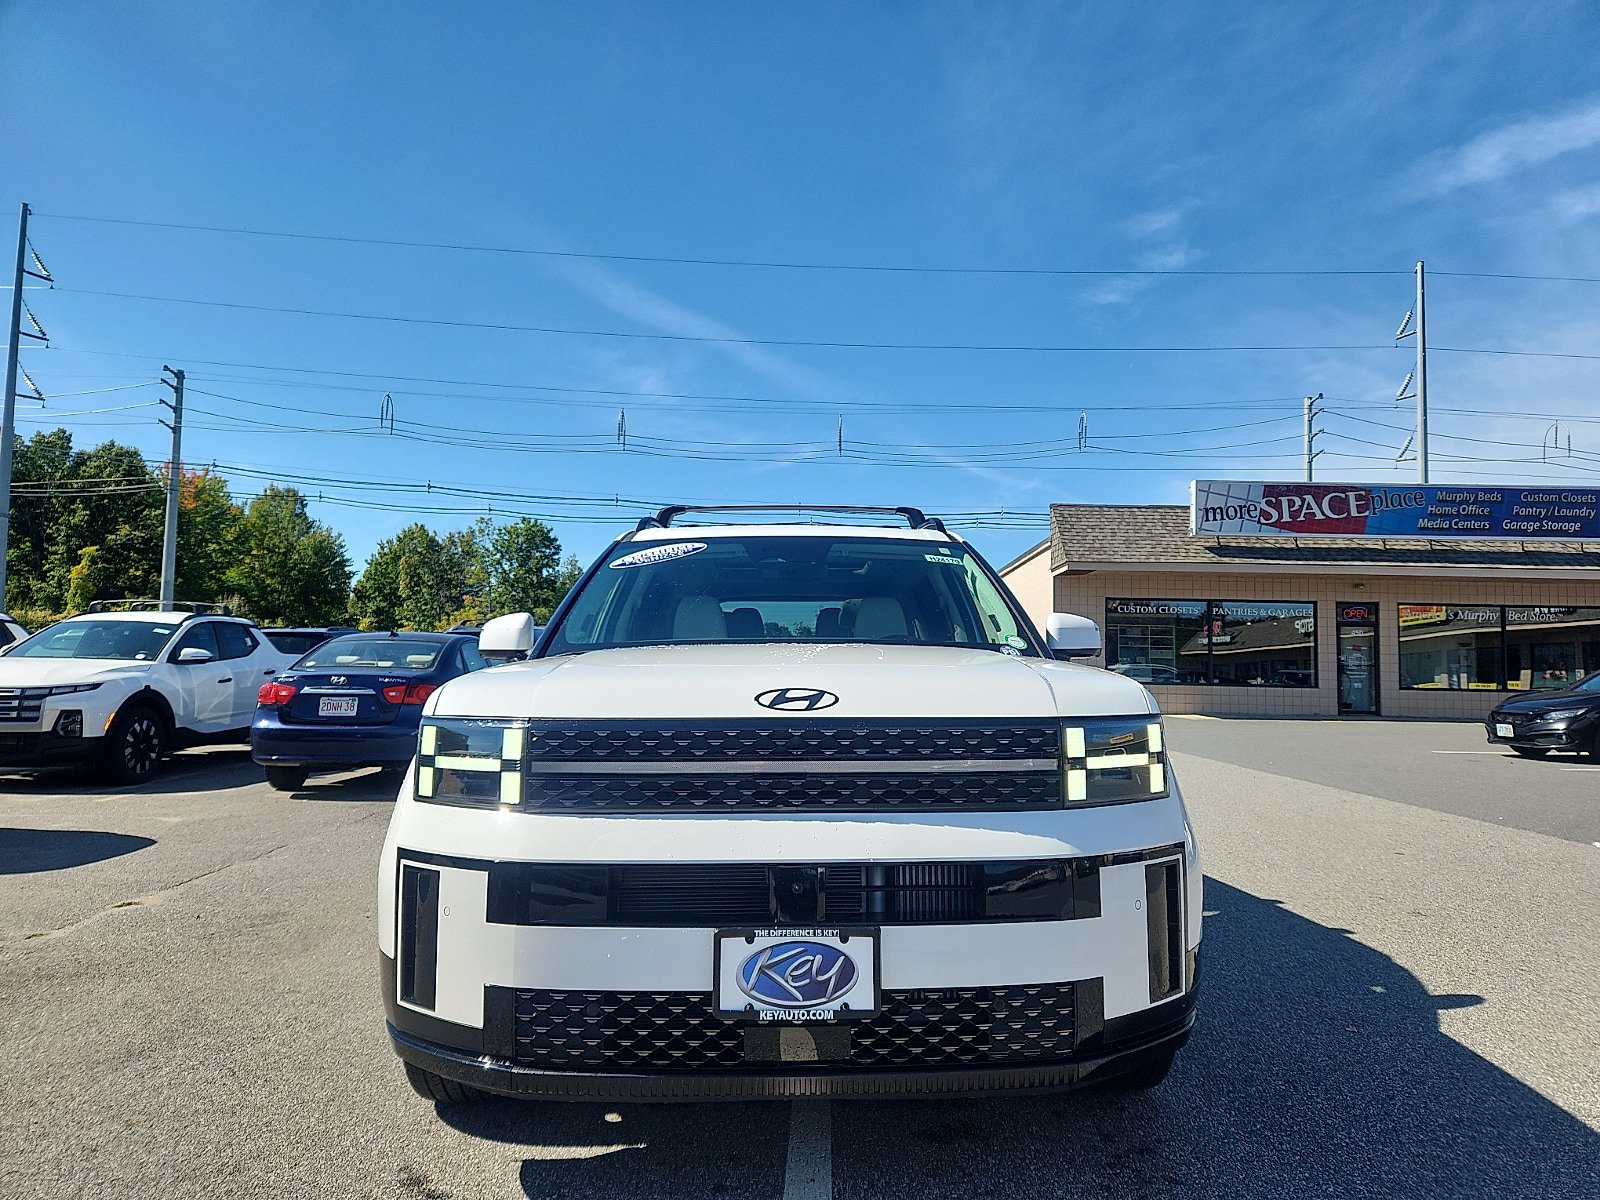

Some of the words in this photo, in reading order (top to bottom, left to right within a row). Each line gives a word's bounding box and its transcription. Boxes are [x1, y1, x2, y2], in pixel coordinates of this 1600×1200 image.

[1436, 491, 1475, 504] Murphy
[1477, 491, 1502, 501] Beds
[1520, 492, 1559, 502] Custom
[1561, 493, 1597, 503] Closets
[1427, 505, 1457, 515] Home
[1459, 505, 1490, 515] Office
[1512, 506, 1547, 519] Pantry
[1554, 507, 1596, 519] Laundry
[1417, 519, 1449, 529] Media
[1451, 519, 1490, 529] Centers
[1502, 520, 1540, 532] Garage
[1542, 520, 1581, 532] Storage
[1117, 605, 1157, 614] CUSTOM
[1212, 607, 1258, 616] PANTRIES
[1259, 608, 1268, 616] &
[1268, 608, 1313, 617] GARAGES
[1343, 609, 1368, 618] OPEN
[1456, 609, 1499, 623] Murphy
[1508, 610, 1528, 621] Bed
[344, 702, 355, 711] 38
[748, 947, 845, 1002] Key
[759, 1009, 834, 1020] KEYAUTO.COM
